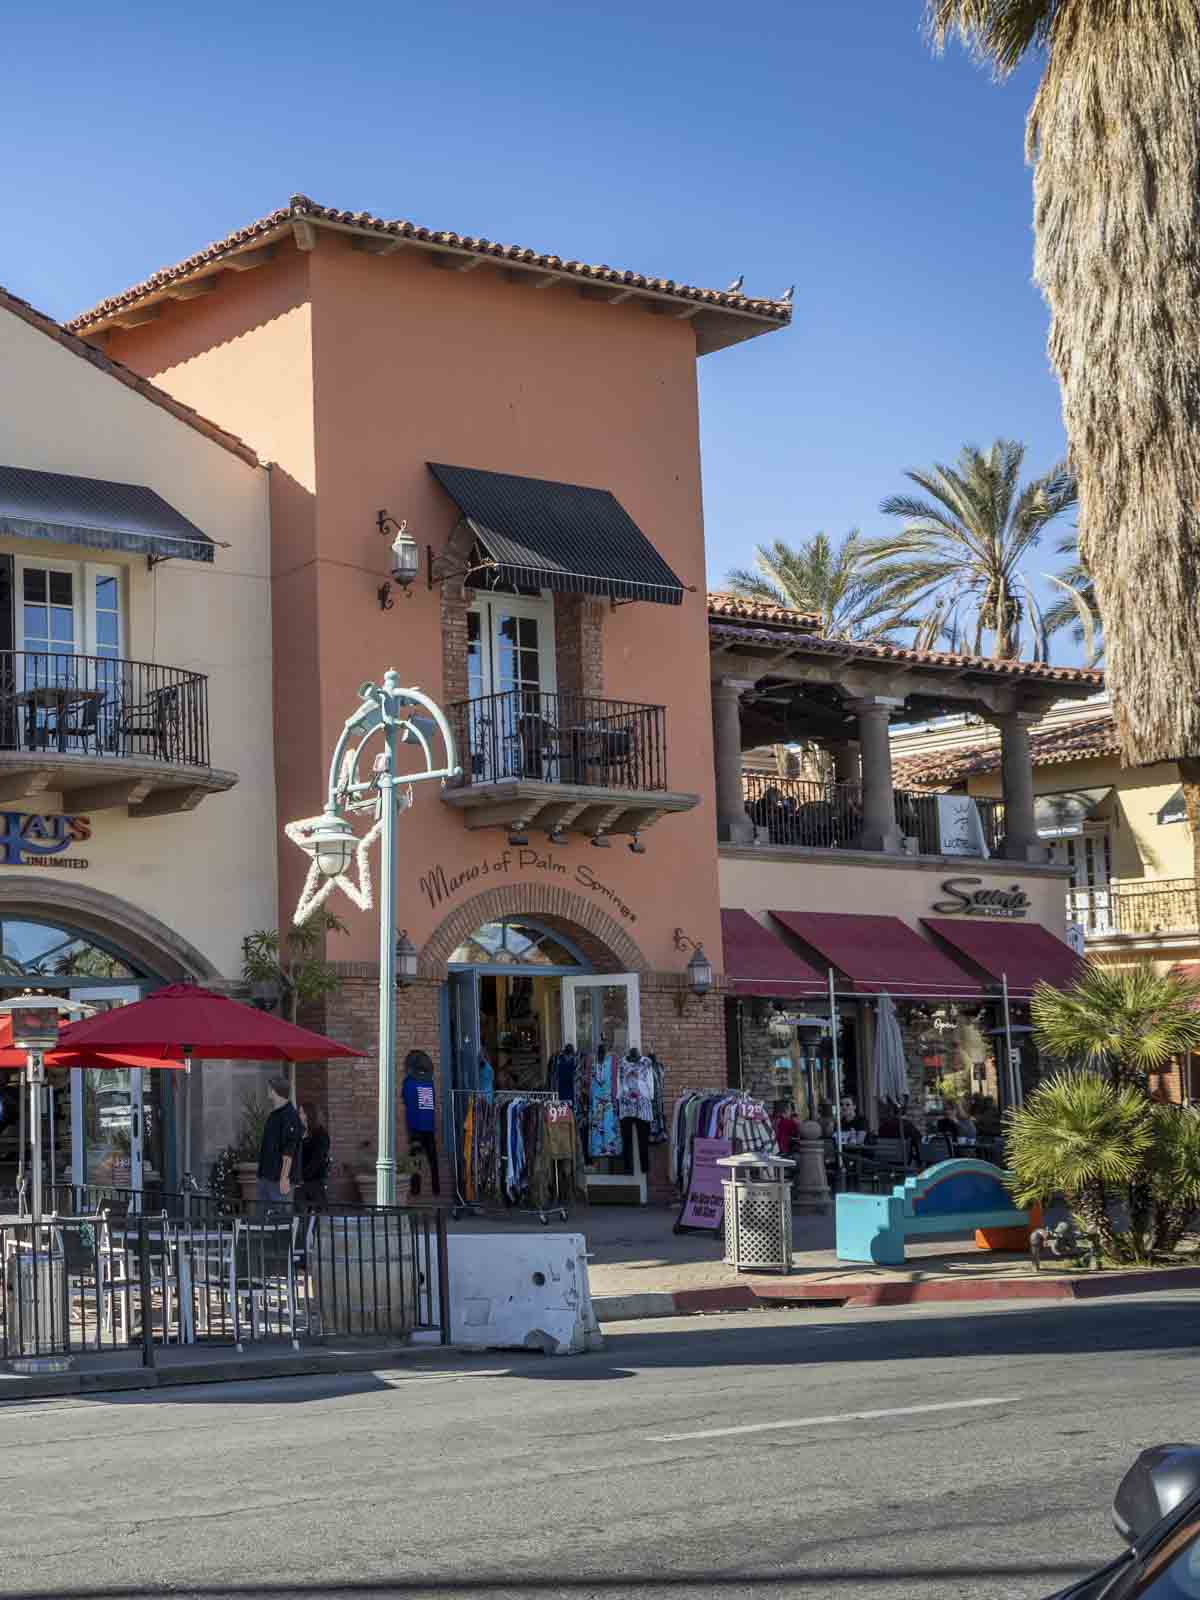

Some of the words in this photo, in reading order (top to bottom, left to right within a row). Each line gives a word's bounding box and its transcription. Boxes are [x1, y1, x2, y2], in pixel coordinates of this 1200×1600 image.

[26, 856, 89, 869] UNLIMITED
[493, 850, 513, 873] of
[519, 849, 568, 874] Palm
[575, 864, 637, 922] Springs
[934, 1018, 958, 1034] Open
